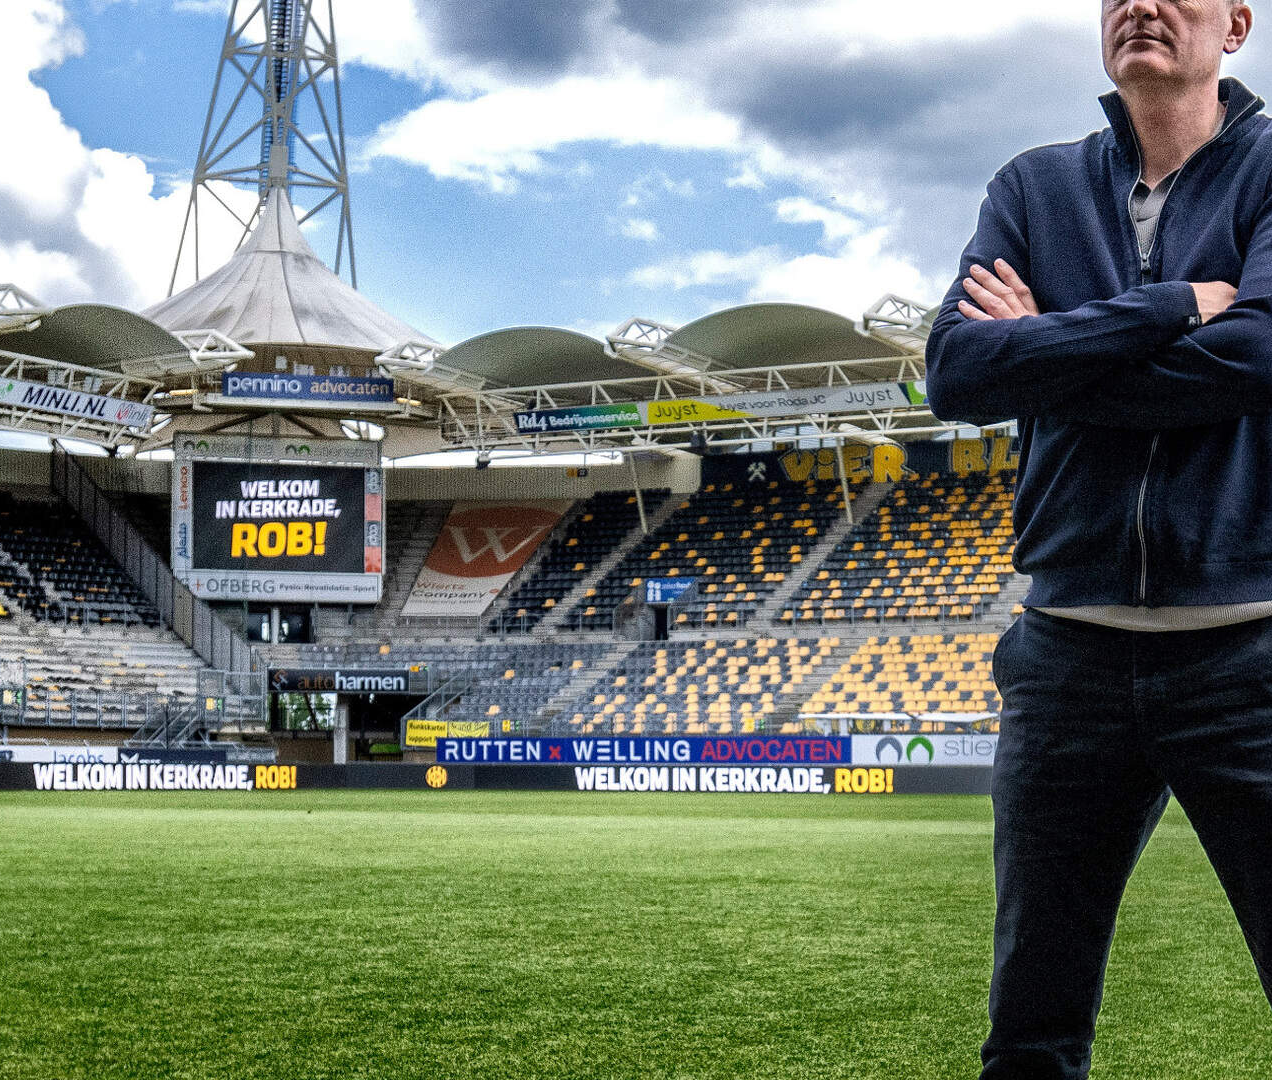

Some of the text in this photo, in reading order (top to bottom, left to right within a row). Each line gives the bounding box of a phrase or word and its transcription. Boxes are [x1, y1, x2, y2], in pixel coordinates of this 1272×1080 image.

[227, 374, 390, 396] pennino advocaten
[21, 385, 107, 418] MINLI.NL
[844, 388, 894, 407] Juyst
[517, 411, 641, 431] Rd4 Bedrijvenservice
[654, 401, 700, 421] Juyst
[240, 479, 321, 499] WELKOM
[215, 497, 342, 520] IN KERKRADE,
[231, 520, 329, 559] ROB!
[411, 589, 487, 600] Company
[445, 739, 541, 761] RUTTEN
[572, 739, 691, 762] WELLING
[700, 739, 843, 761] ADVOCATEN
[943, 735, 997, 757] stie
[33, 763, 297, 791] WELKOM IN KERKRADE, ROB!
[575, 765, 895, 793] WELKOM IN KERKRADE, ROB!
